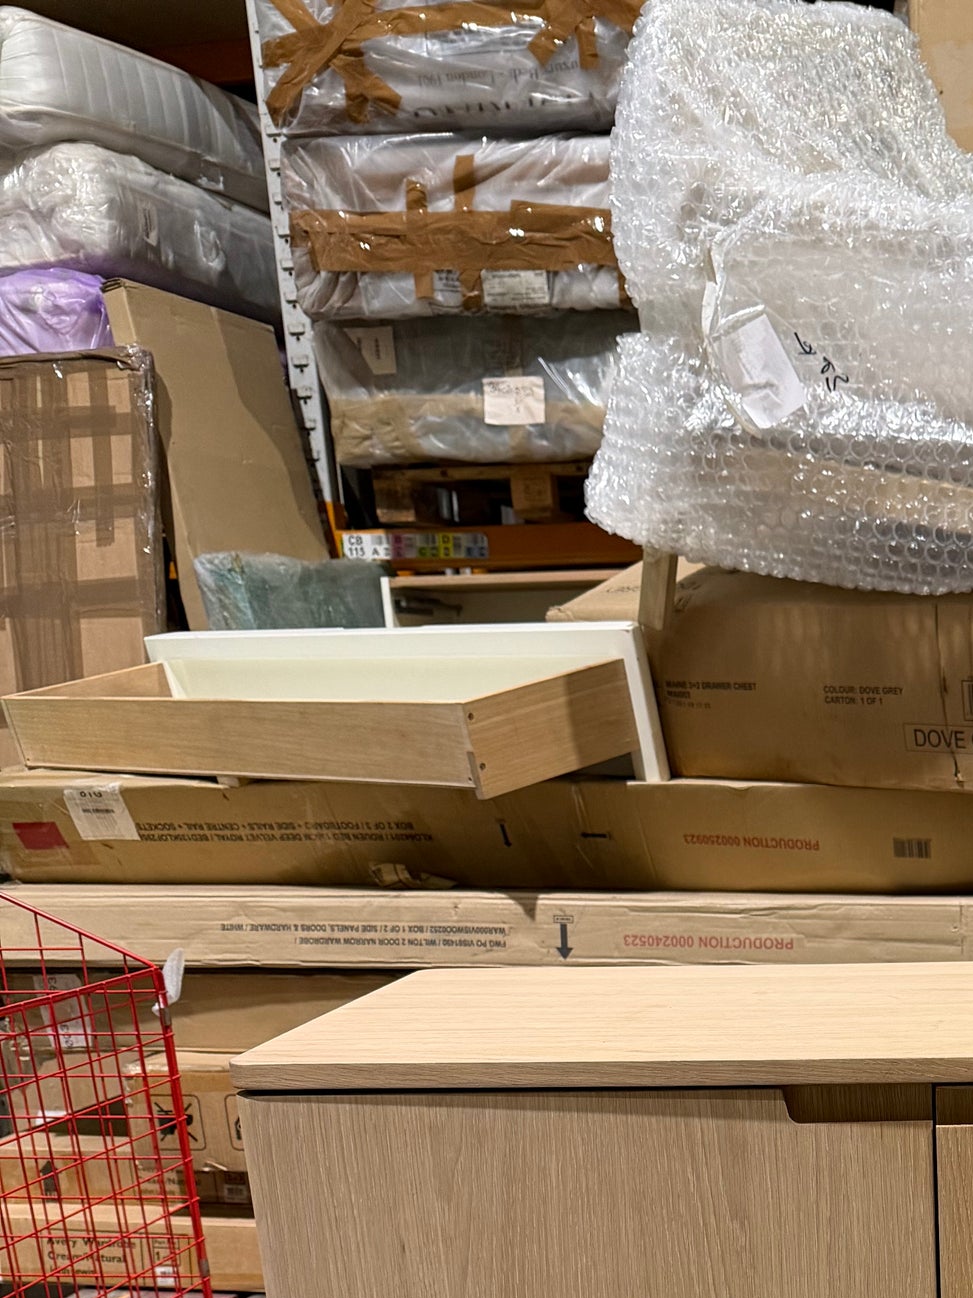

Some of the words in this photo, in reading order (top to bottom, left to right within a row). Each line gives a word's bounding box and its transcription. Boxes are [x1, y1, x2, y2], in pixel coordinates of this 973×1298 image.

[446, 70, 495, 87] London
[733, 683, 757, 691] CHEST
[859, 686, 881, 695] DOVE
[882, 687, 904, 696] GREY
[913, 729, 966, 750] DOVE
[184, 822, 204, 831] RAIL
[204, 822, 239, 831] CENTRE
[248, 822, 274, 830] RAILS
[374, 822, 385, 830] OF
[214, 833, 244, 841] ROYAL
[246, 833, 278, 841] VELVET
[280, 833, 302, 841] DEEP
[743, 836, 820, 851] PRODUCTION
[220, 923, 244, 932] WHITE
[250, 923, 291, 932] HARDWARE
[301, 924, 327, 932] DOORS
[361, 924, 378, 932] SIDE
[390, 925, 400, 933] OF
[408, 925, 424, 934] BOX
[299, 937, 341, 945] WARDROBE
[378, 938, 400, 946] DOOR
[408, 938, 437, 946] WILTON
[476, 940, 487, 948] PO
[623, 934, 694, 949] 000240523
[699, 935, 794, 950] PRODUCTION
